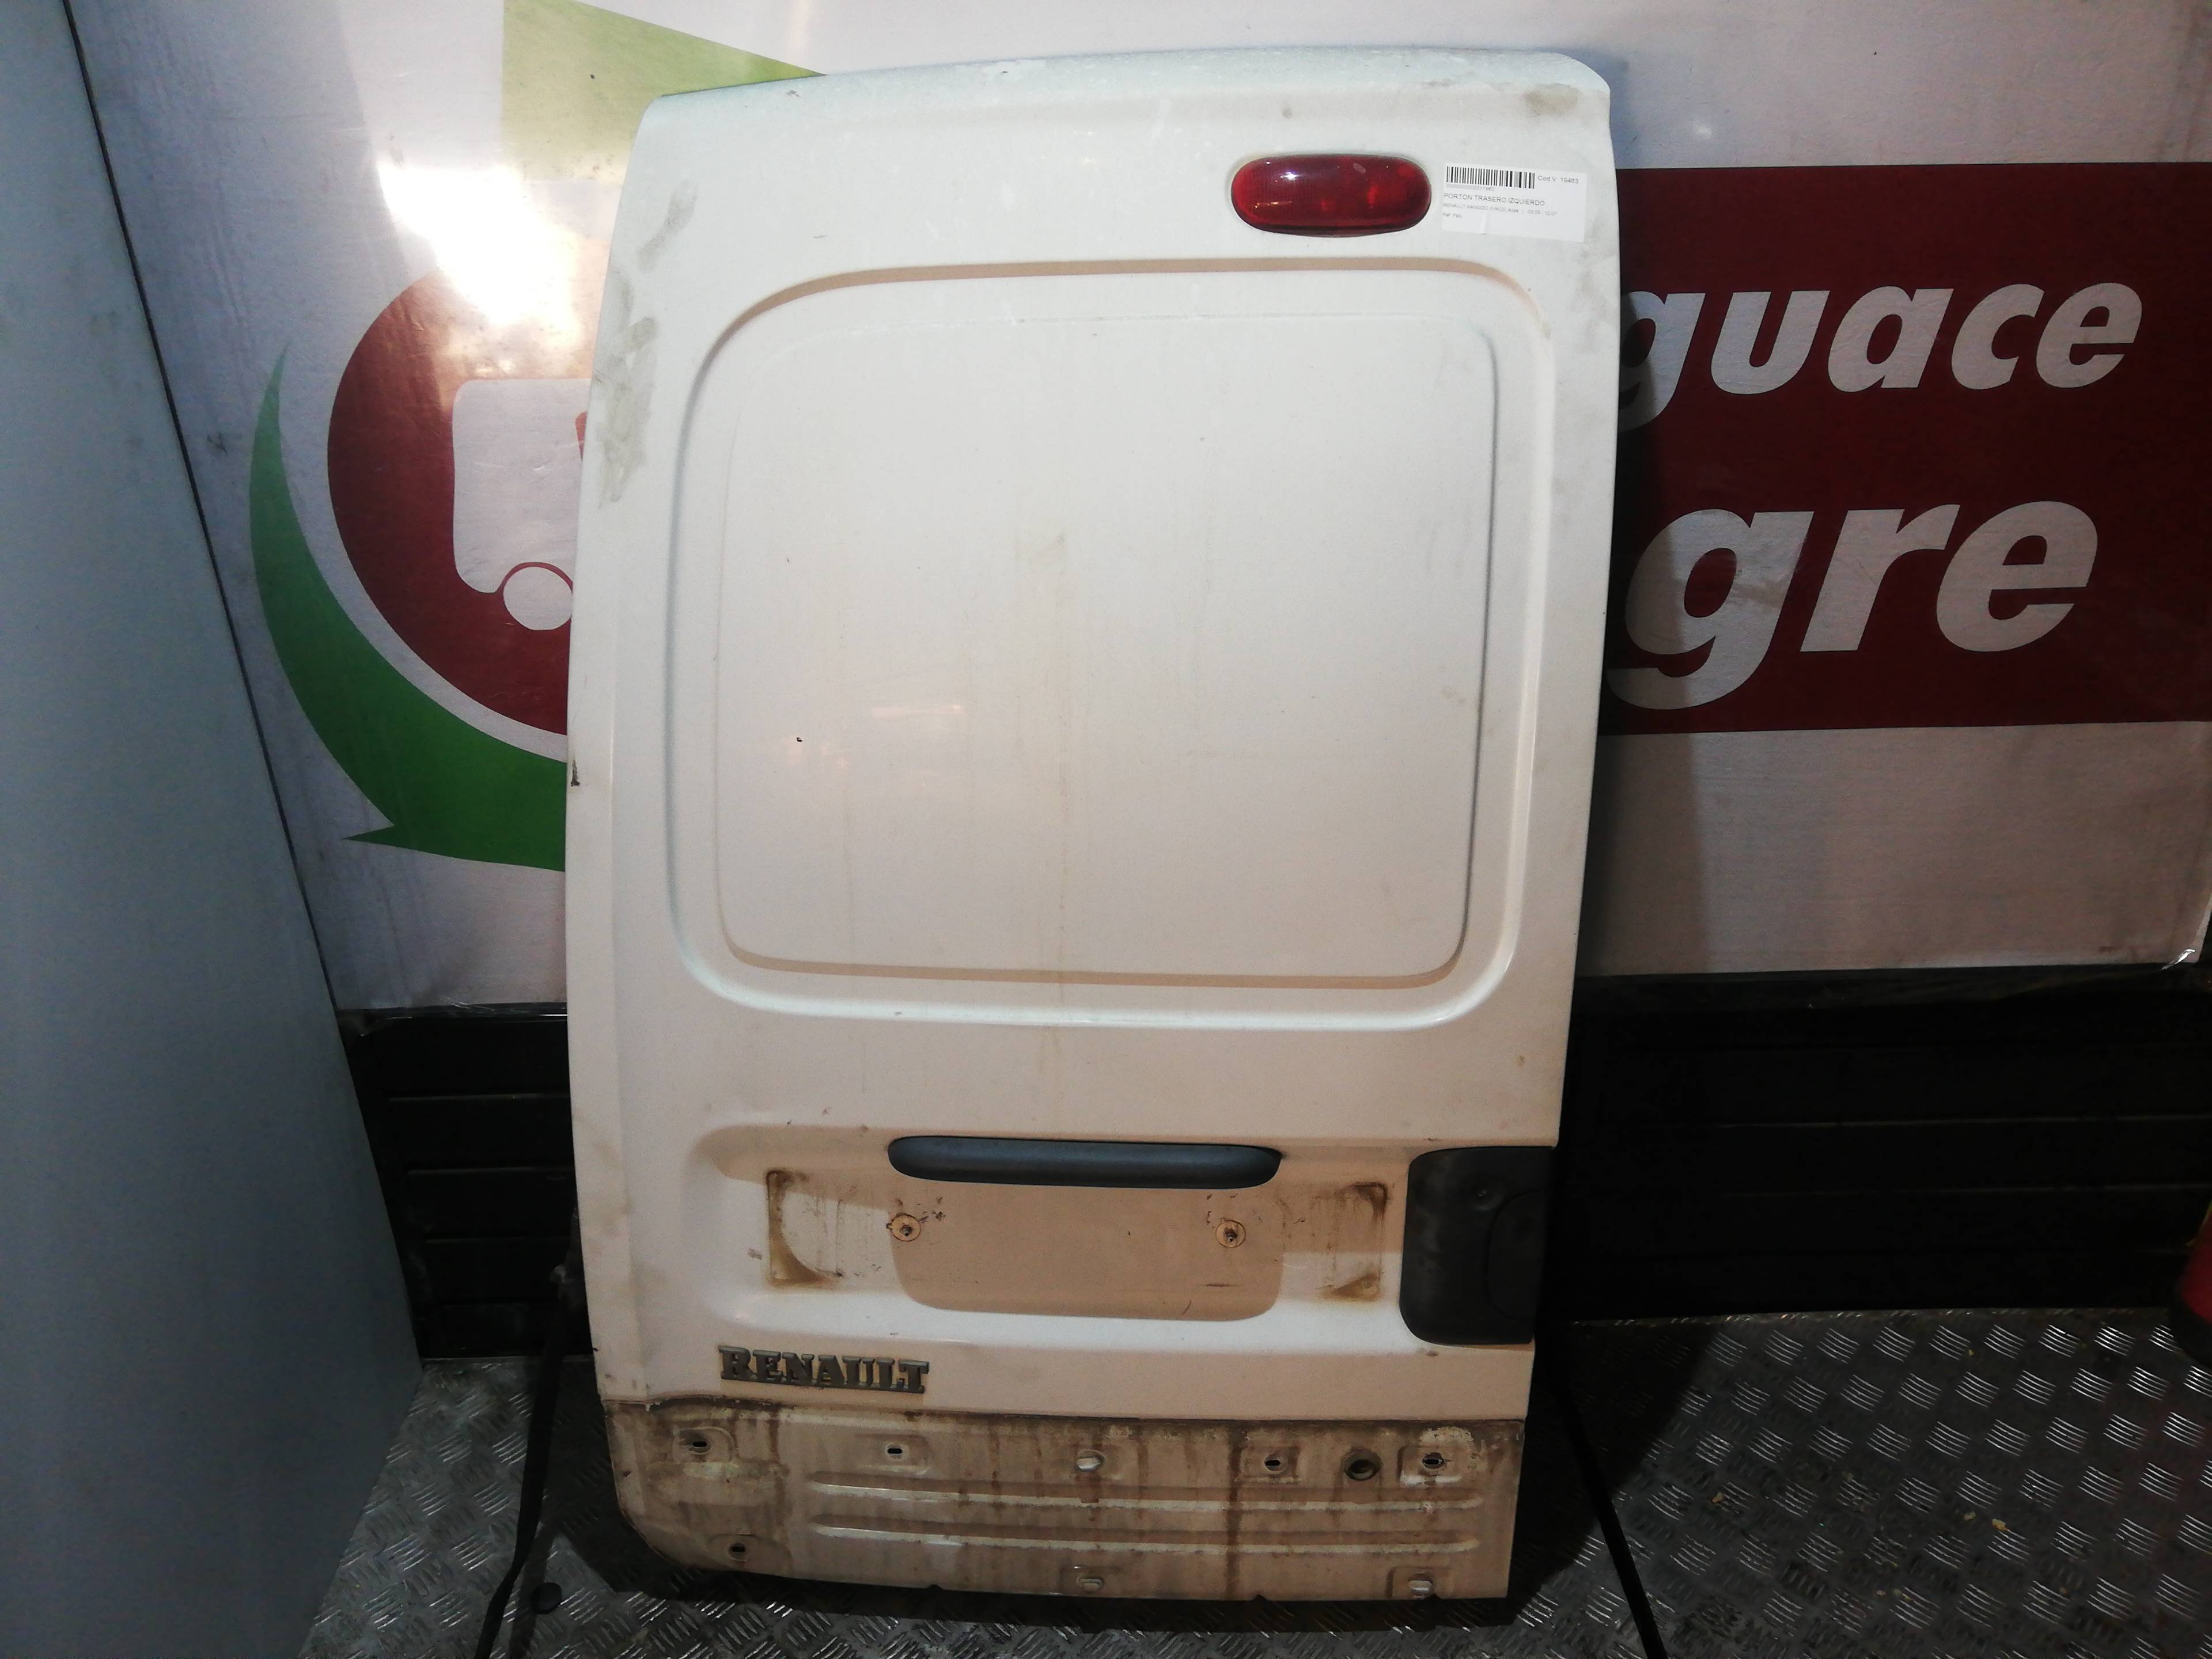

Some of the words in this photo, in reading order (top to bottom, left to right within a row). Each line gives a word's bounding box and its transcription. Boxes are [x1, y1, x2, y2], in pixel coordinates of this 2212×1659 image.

[1444, 192, 1472, 200] PORTON
[1474, 195, 1506, 203] TRASERO
[1508, 198, 1545, 206] IZQUIERDO
[1616, 282, 2143, 434] guace
[1606, 501, 2099, 710] gre
[718, 1346, 930, 1394] RENAULT
